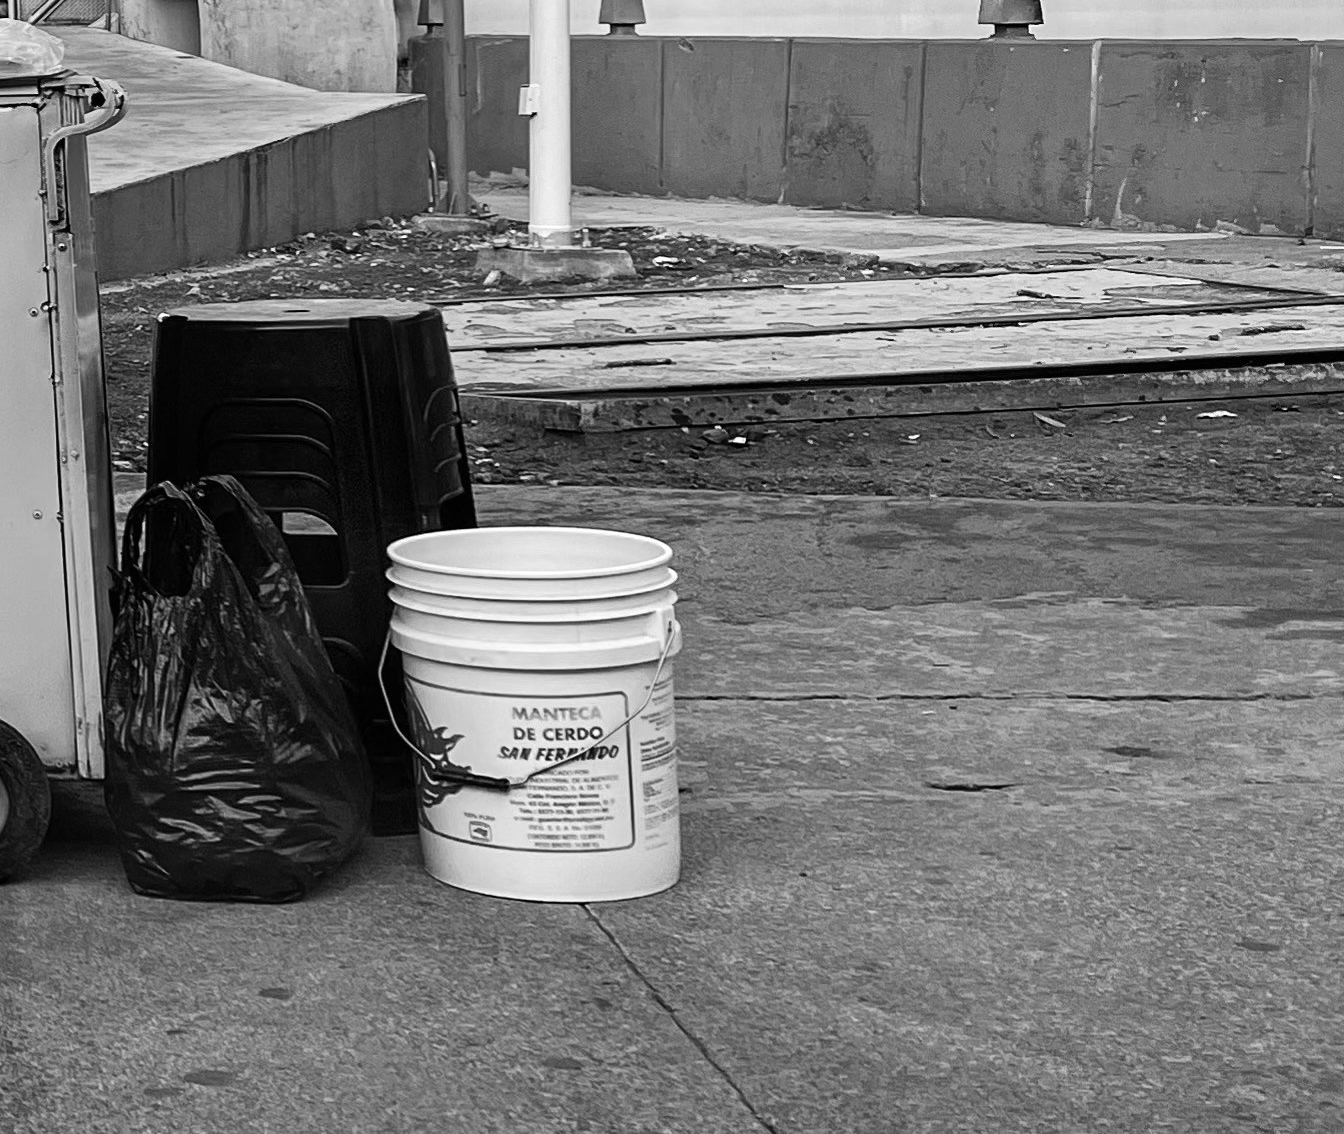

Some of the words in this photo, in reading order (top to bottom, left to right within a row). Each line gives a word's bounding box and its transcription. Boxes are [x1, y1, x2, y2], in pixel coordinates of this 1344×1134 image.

[511, 705, 602, 721] MANTECA
[512, 726, 537, 742] DE
[542, 725, 604, 742] CERDO
[497, 745, 532, 761] SAN
[535, 744, 620, 762] FERNANDO
